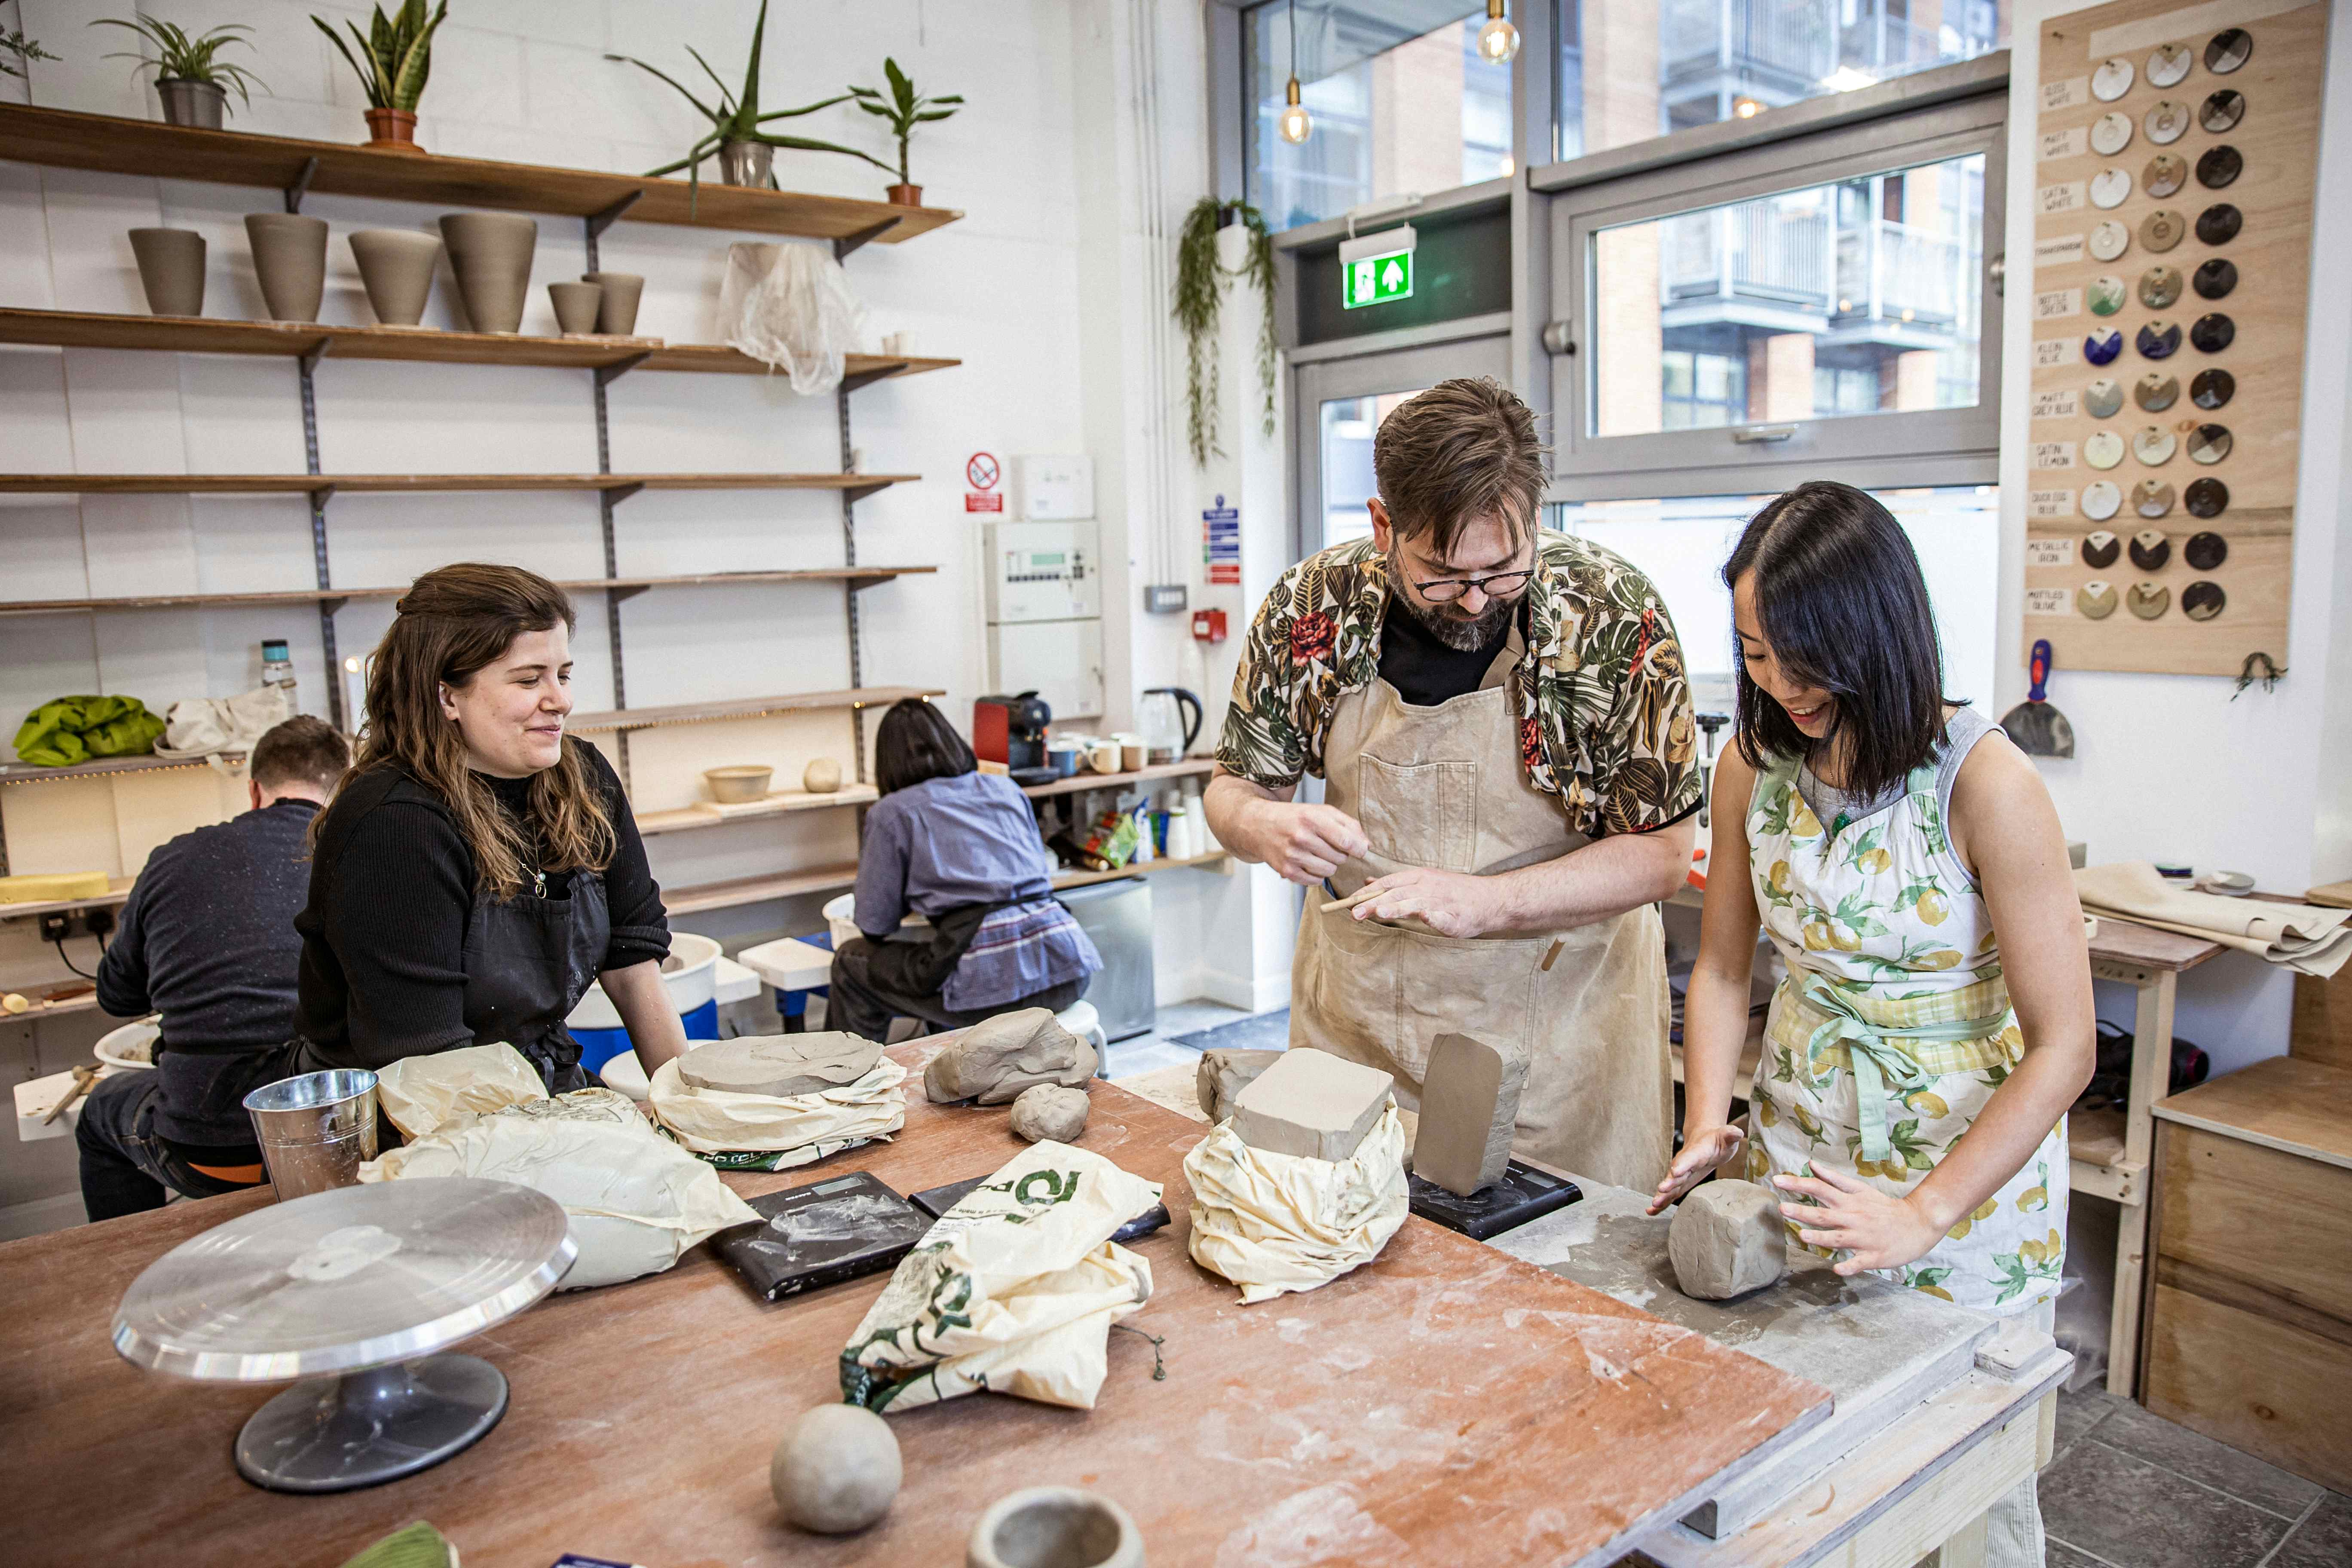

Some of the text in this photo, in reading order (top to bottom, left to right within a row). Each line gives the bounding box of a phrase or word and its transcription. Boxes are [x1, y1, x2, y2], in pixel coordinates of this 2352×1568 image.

[2046, 195, 2073, 211] WHITE
[2028, 541, 2069, 551] METALLIC
[2038, 553, 2059, 563] IRON
[2027, 590, 2064, 599] MOTTLED
[2033, 600, 2057, 610] OLIVE
